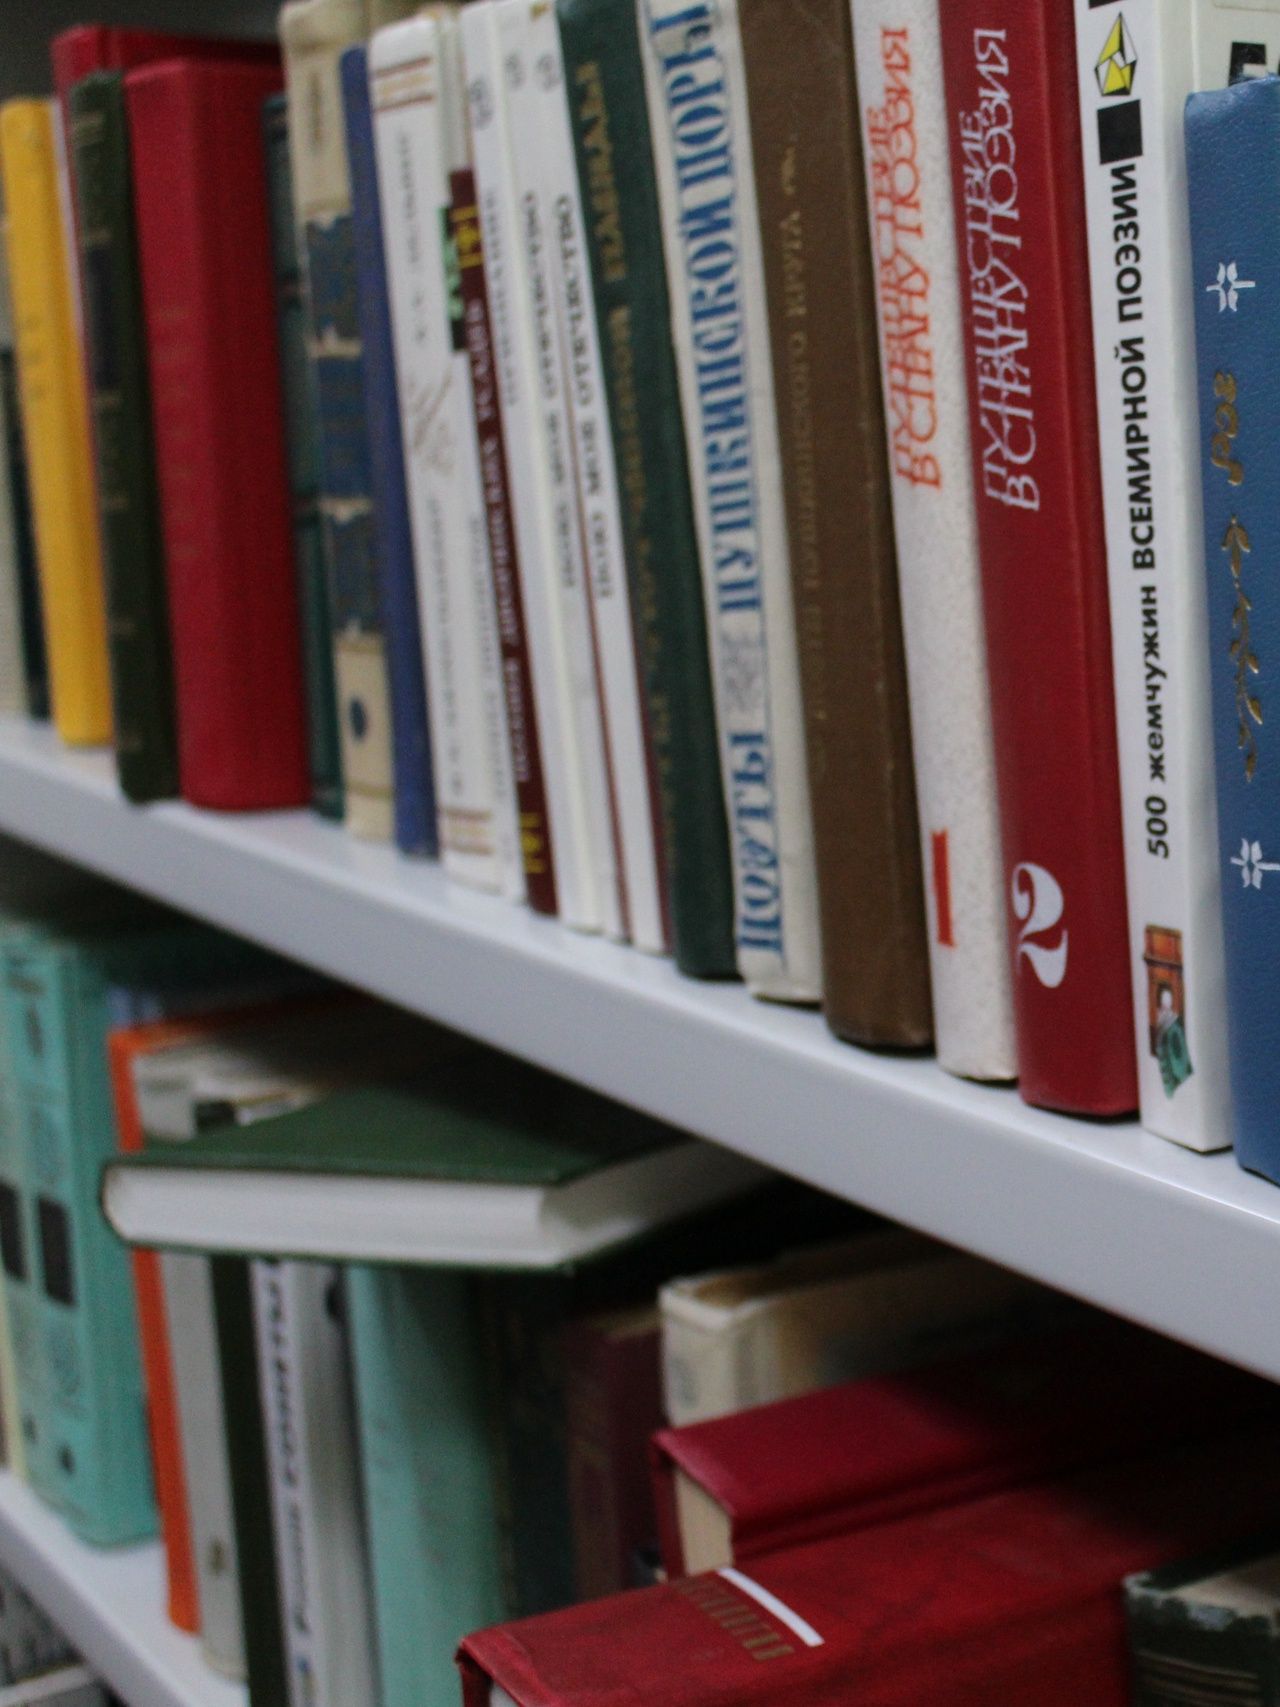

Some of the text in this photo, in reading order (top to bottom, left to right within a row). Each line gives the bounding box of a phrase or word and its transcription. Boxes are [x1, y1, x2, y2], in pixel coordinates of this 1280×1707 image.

[894, 252, 936, 445] СТРАНУ
[961, 111, 1008, 502] ПУТЕШЕСТВИЕ
[974, 28, 1040, 510] В СТРАНУ ПОЭЗИЯ
[652, 5, 783, 953] ПОЭТЫ ПУШКИНСКОЙ ПОРЫ
[911, 455, 941, 491] В
[1110, 162, 1170, 859] 500 жемчужин ВСЕМИРНОЙ ПОЭЗИИ
[1012, 861, 1068, 988] 2
